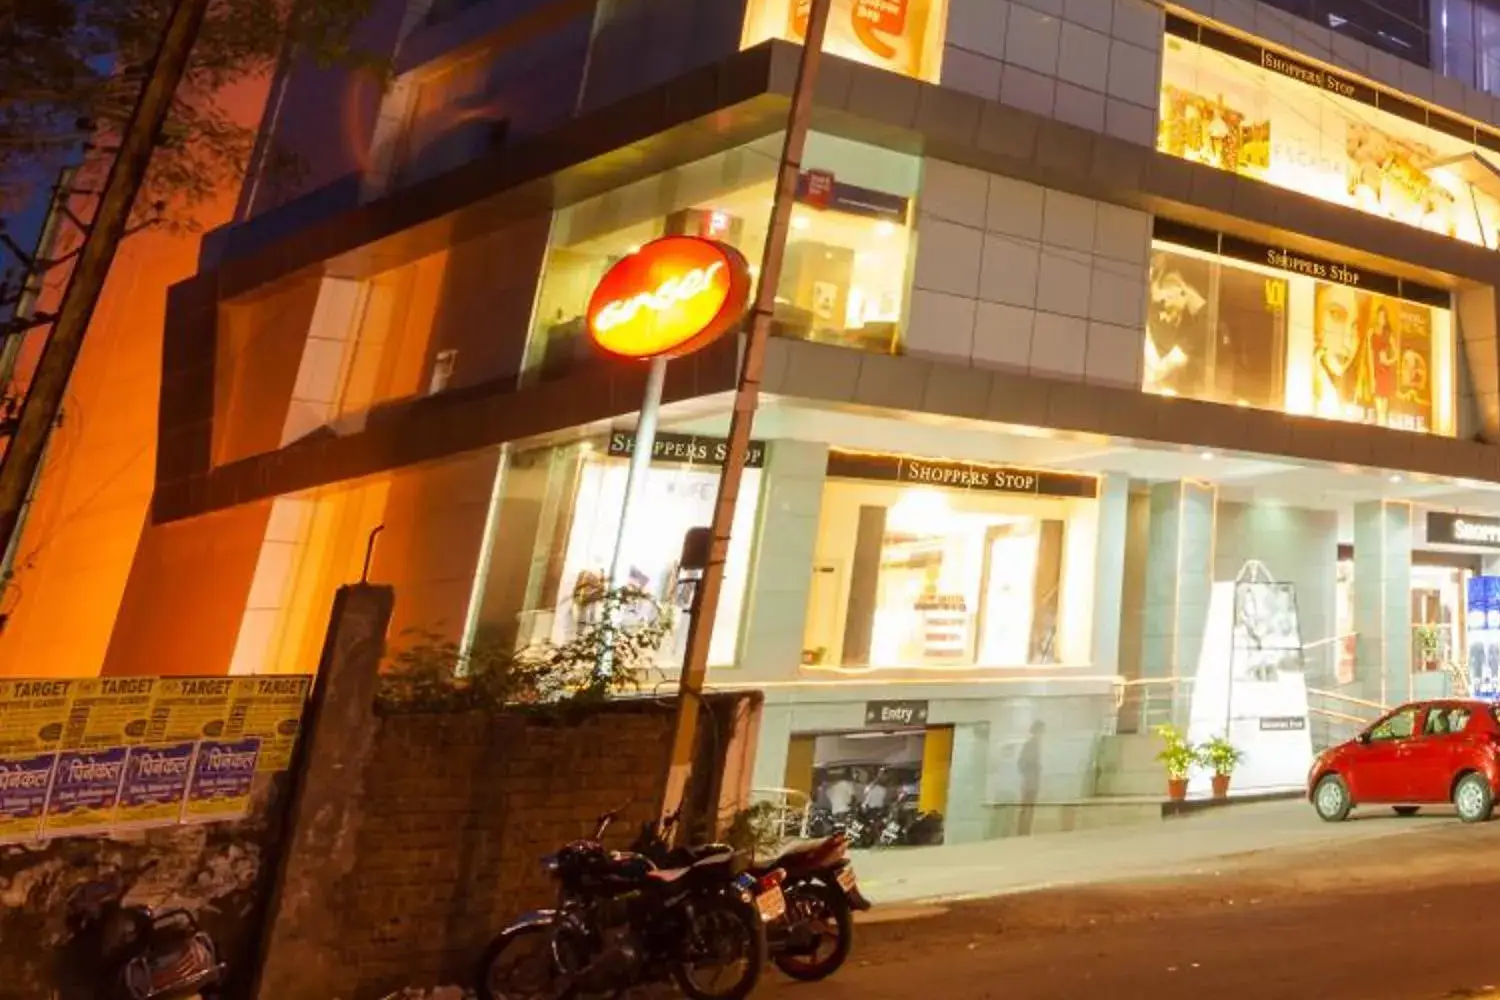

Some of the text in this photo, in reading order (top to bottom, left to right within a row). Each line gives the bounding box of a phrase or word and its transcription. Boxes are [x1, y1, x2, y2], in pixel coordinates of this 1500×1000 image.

[1329, 265, 1360, 285] STOP
[611, 433, 707, 459] SHPPERS
[909, 461, 1034, 490] SHOPPERS STOP
[13, 681, 70, 699] TARGET
[101, 679, 154, 694] TARGET
[181, 679, 234, 696] TARGET
[881, 706, 913, 724] Entry
